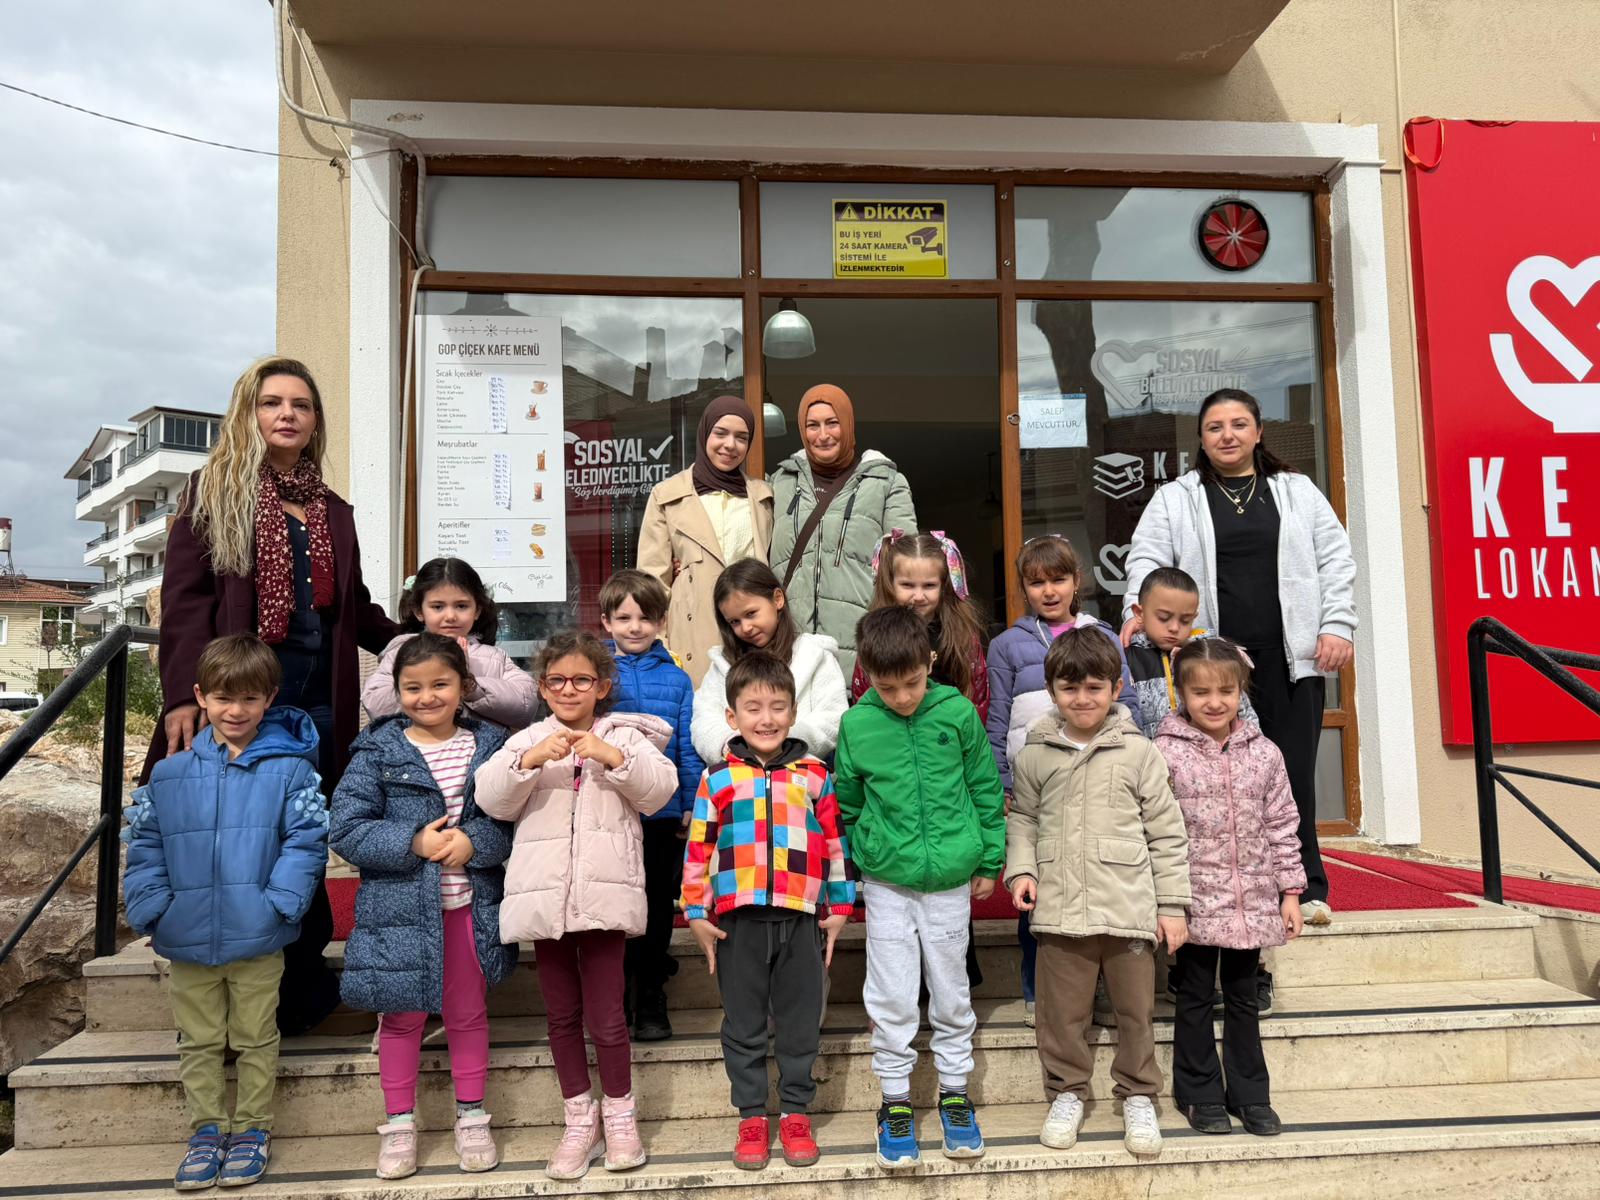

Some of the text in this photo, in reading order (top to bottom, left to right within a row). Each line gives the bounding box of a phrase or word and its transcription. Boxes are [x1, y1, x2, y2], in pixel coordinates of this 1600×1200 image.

[864, 204, 934, 219] DİKKAT
[853, 230, 861, 239] İŞ
[863, 230, 881, 238] YERİ
[840, 253, 887, 261] SİSTEMİ İLE
[840, 264, 905, 272] İZLENMEKTEDİR
[438, 342, 540, 357] GOP ÇİÇEK KAFE MENÜ
[436, 369, 452, 377] Sıcak
[1040, 408, 1064, 416] SALEP
[437, 440, 478, 450] Meşrubatlar
[574, 438, 648, 466] SOSYAL
